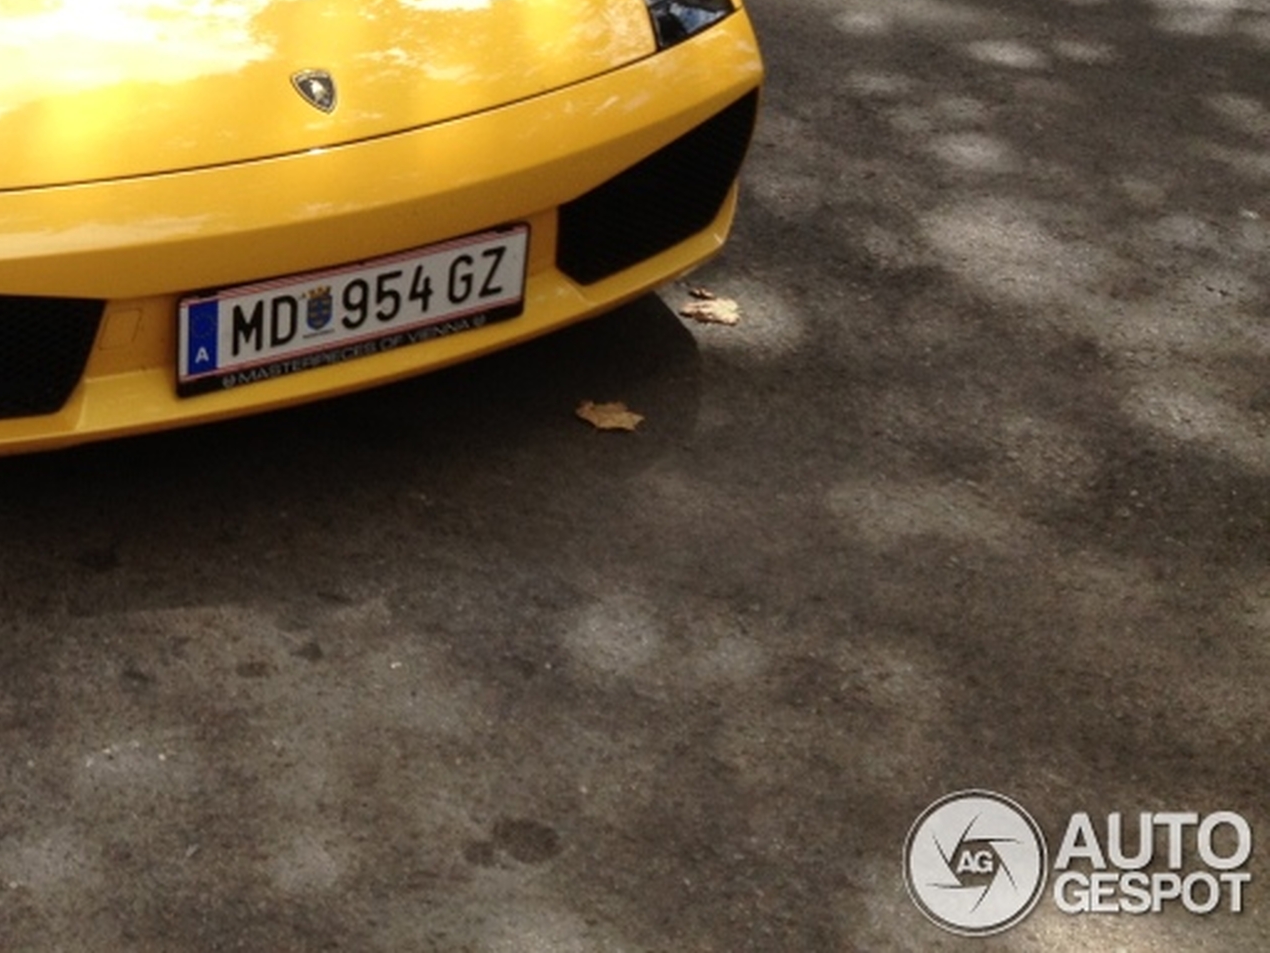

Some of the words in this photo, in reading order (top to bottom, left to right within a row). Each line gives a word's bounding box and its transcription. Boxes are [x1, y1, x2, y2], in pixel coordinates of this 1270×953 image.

[232, 295, 298, 356] MD
[341, 265, 433, 330] 954
[447, 246, 507, 304] GZ
[379, 334, 403, 351] OF
[406, 317, 471, 344] VIENNA
[195, 348, 210, 363] A
